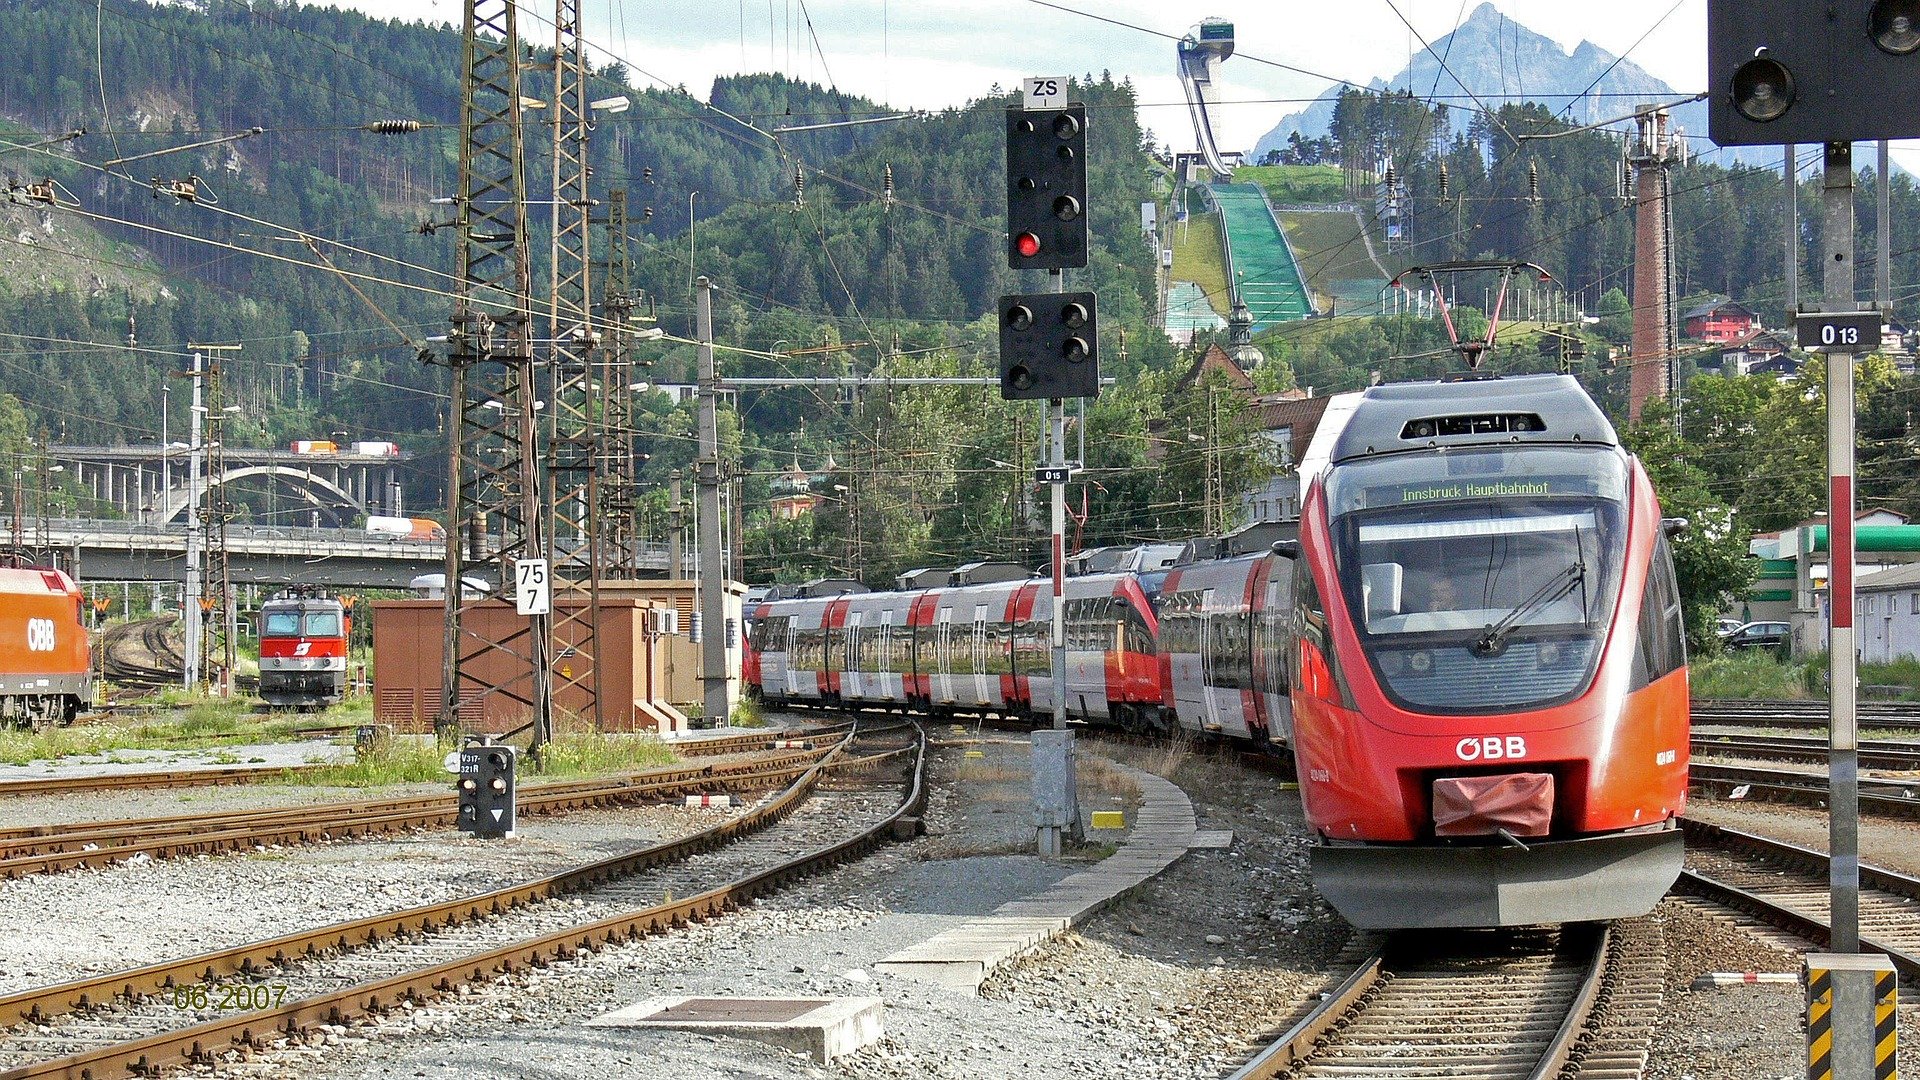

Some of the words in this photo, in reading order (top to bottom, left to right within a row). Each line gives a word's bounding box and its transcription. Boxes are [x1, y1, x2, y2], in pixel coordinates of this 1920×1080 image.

[1033, 80, 1058, 97] ZS
[1839, 327, 1858, 344] 13
[1052, 472, 1061, 480] 15
[1402, 484, 1462, 502] Innsbruck
[1466, 481, 1549, 498] Hauptbahnhof
[520, 564, 544, 585] 75
[527, 589, 538, 610] 7
[1455, 736, 1527, 761] ÖBB
[461, 753, 481, 763] V317-
[460, 764, 479, 773] 321R
